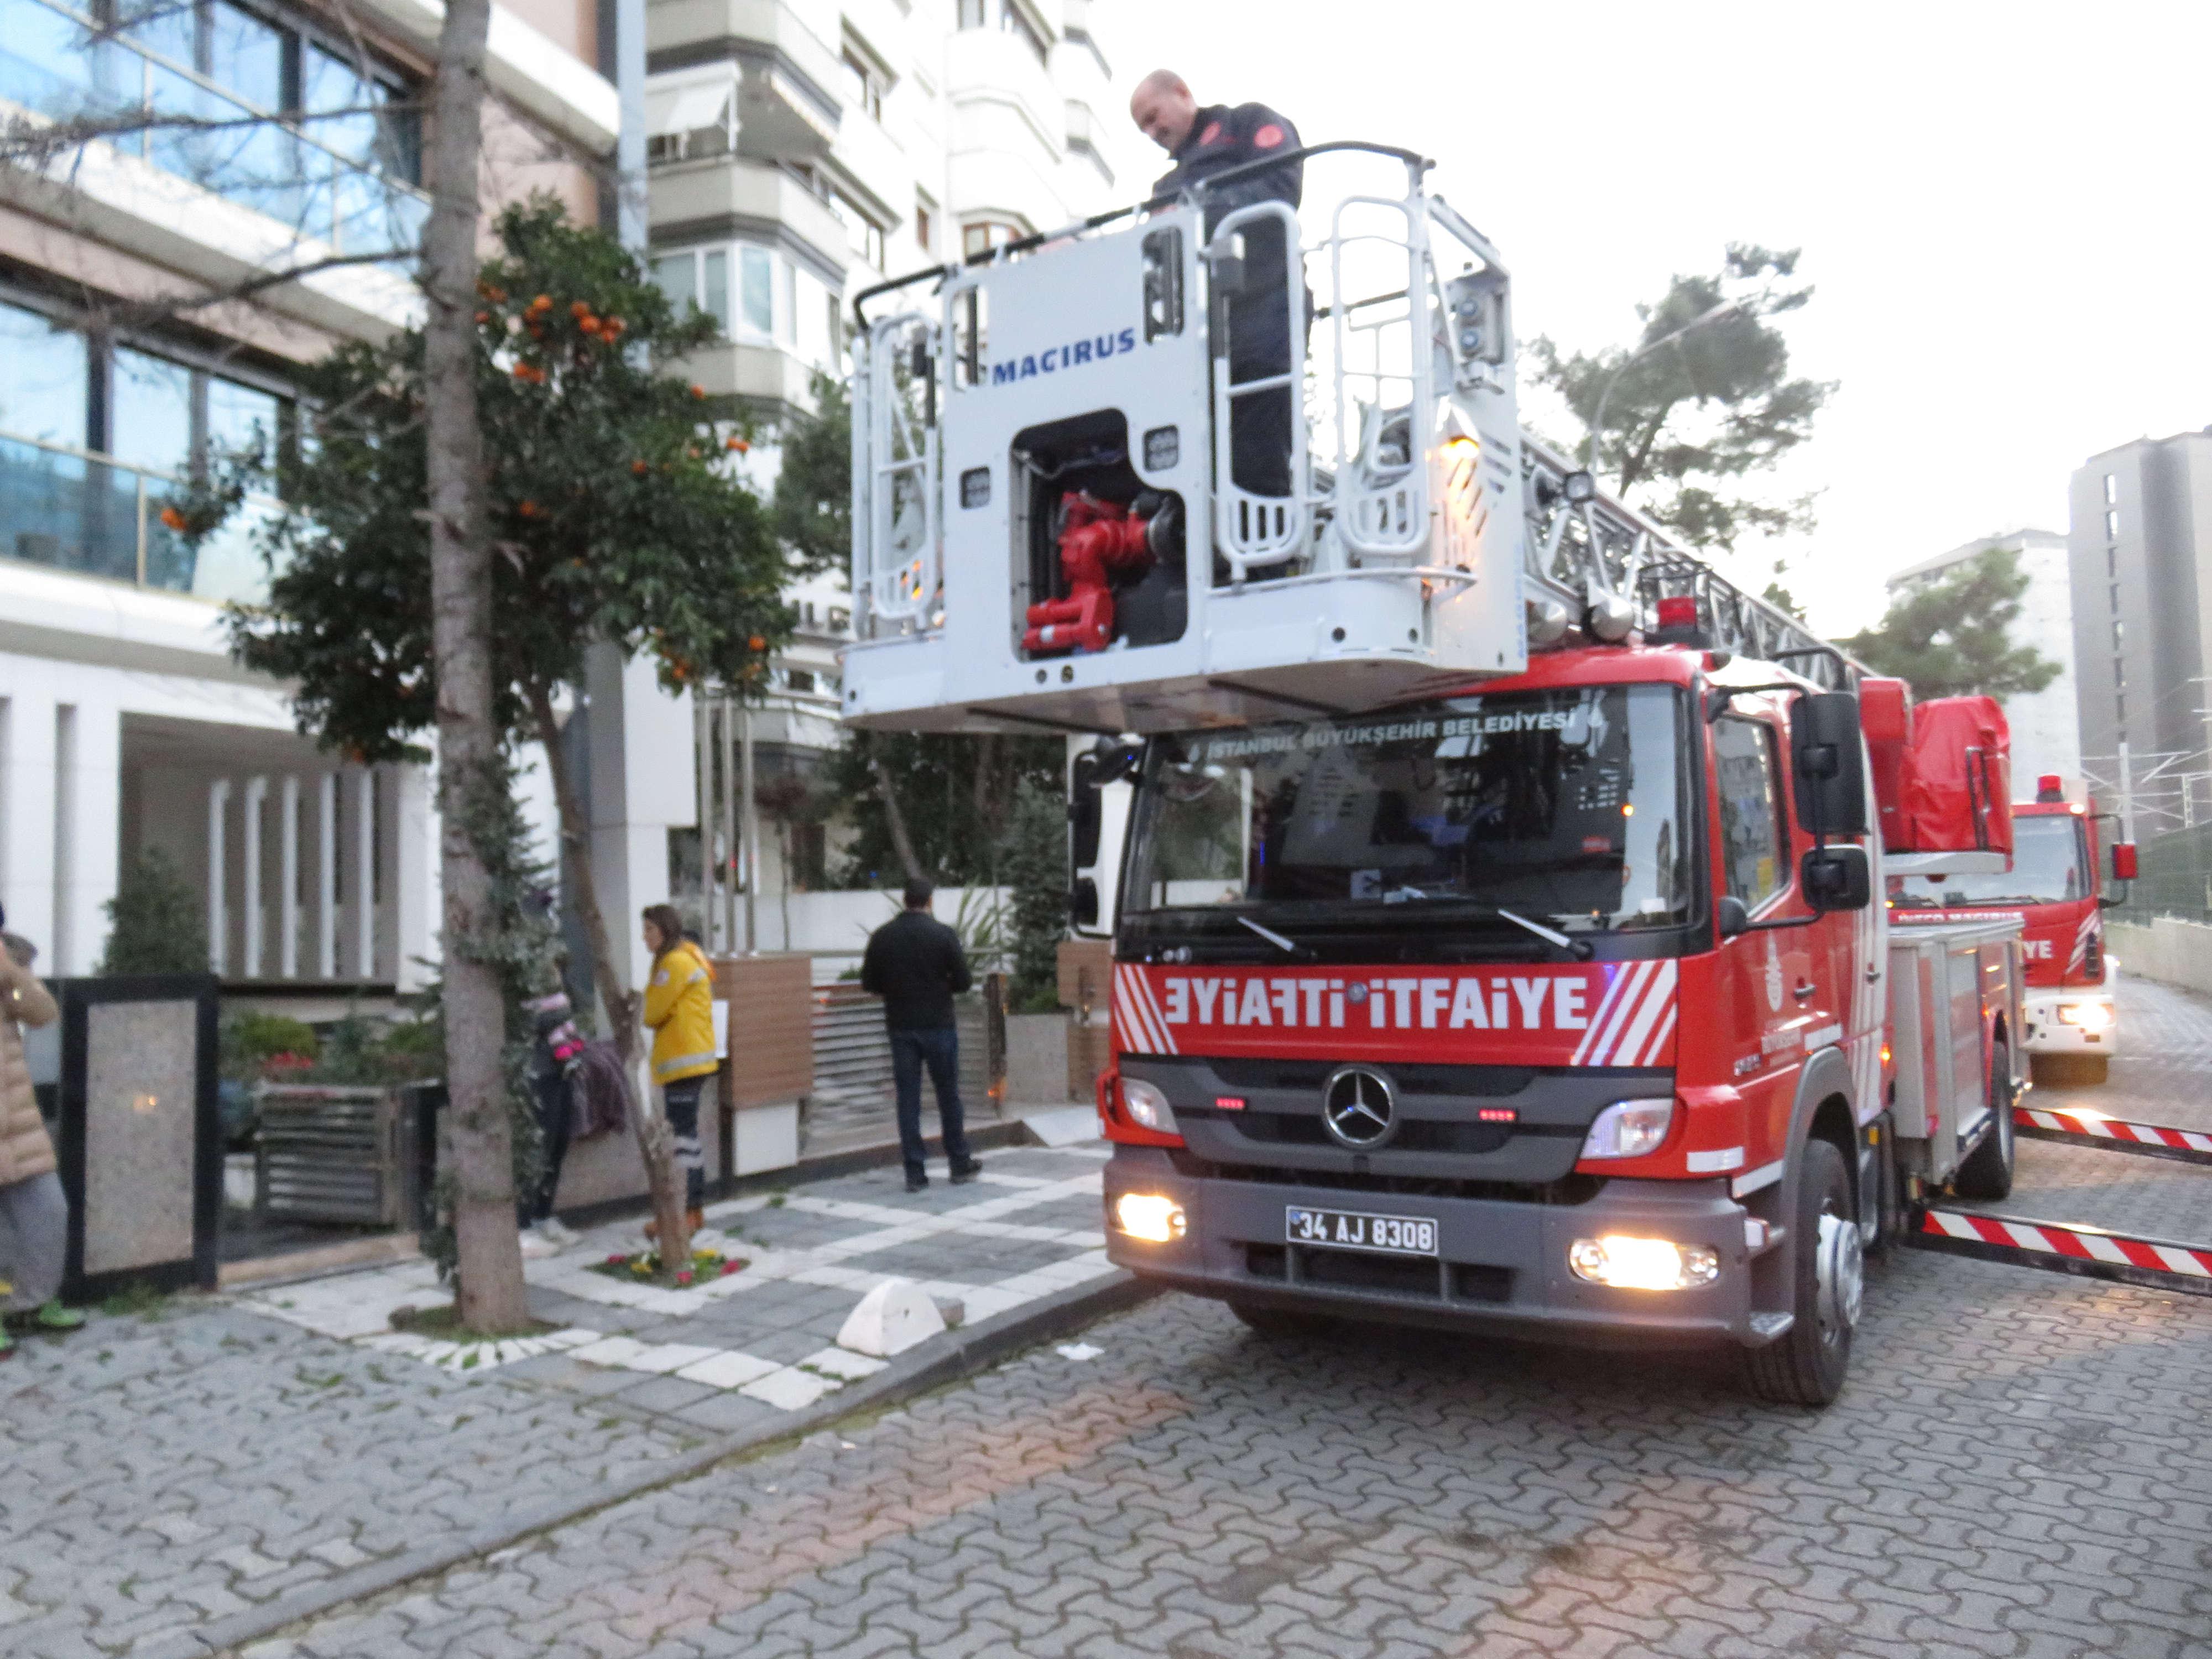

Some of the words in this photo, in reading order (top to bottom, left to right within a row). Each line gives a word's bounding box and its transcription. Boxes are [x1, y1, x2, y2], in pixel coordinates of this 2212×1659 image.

[1300, 1212, 1327, 1240] 34
[1335, 1216, 1365, 1243] AJ
[1372, 1219, 1432, 1250] 8308
